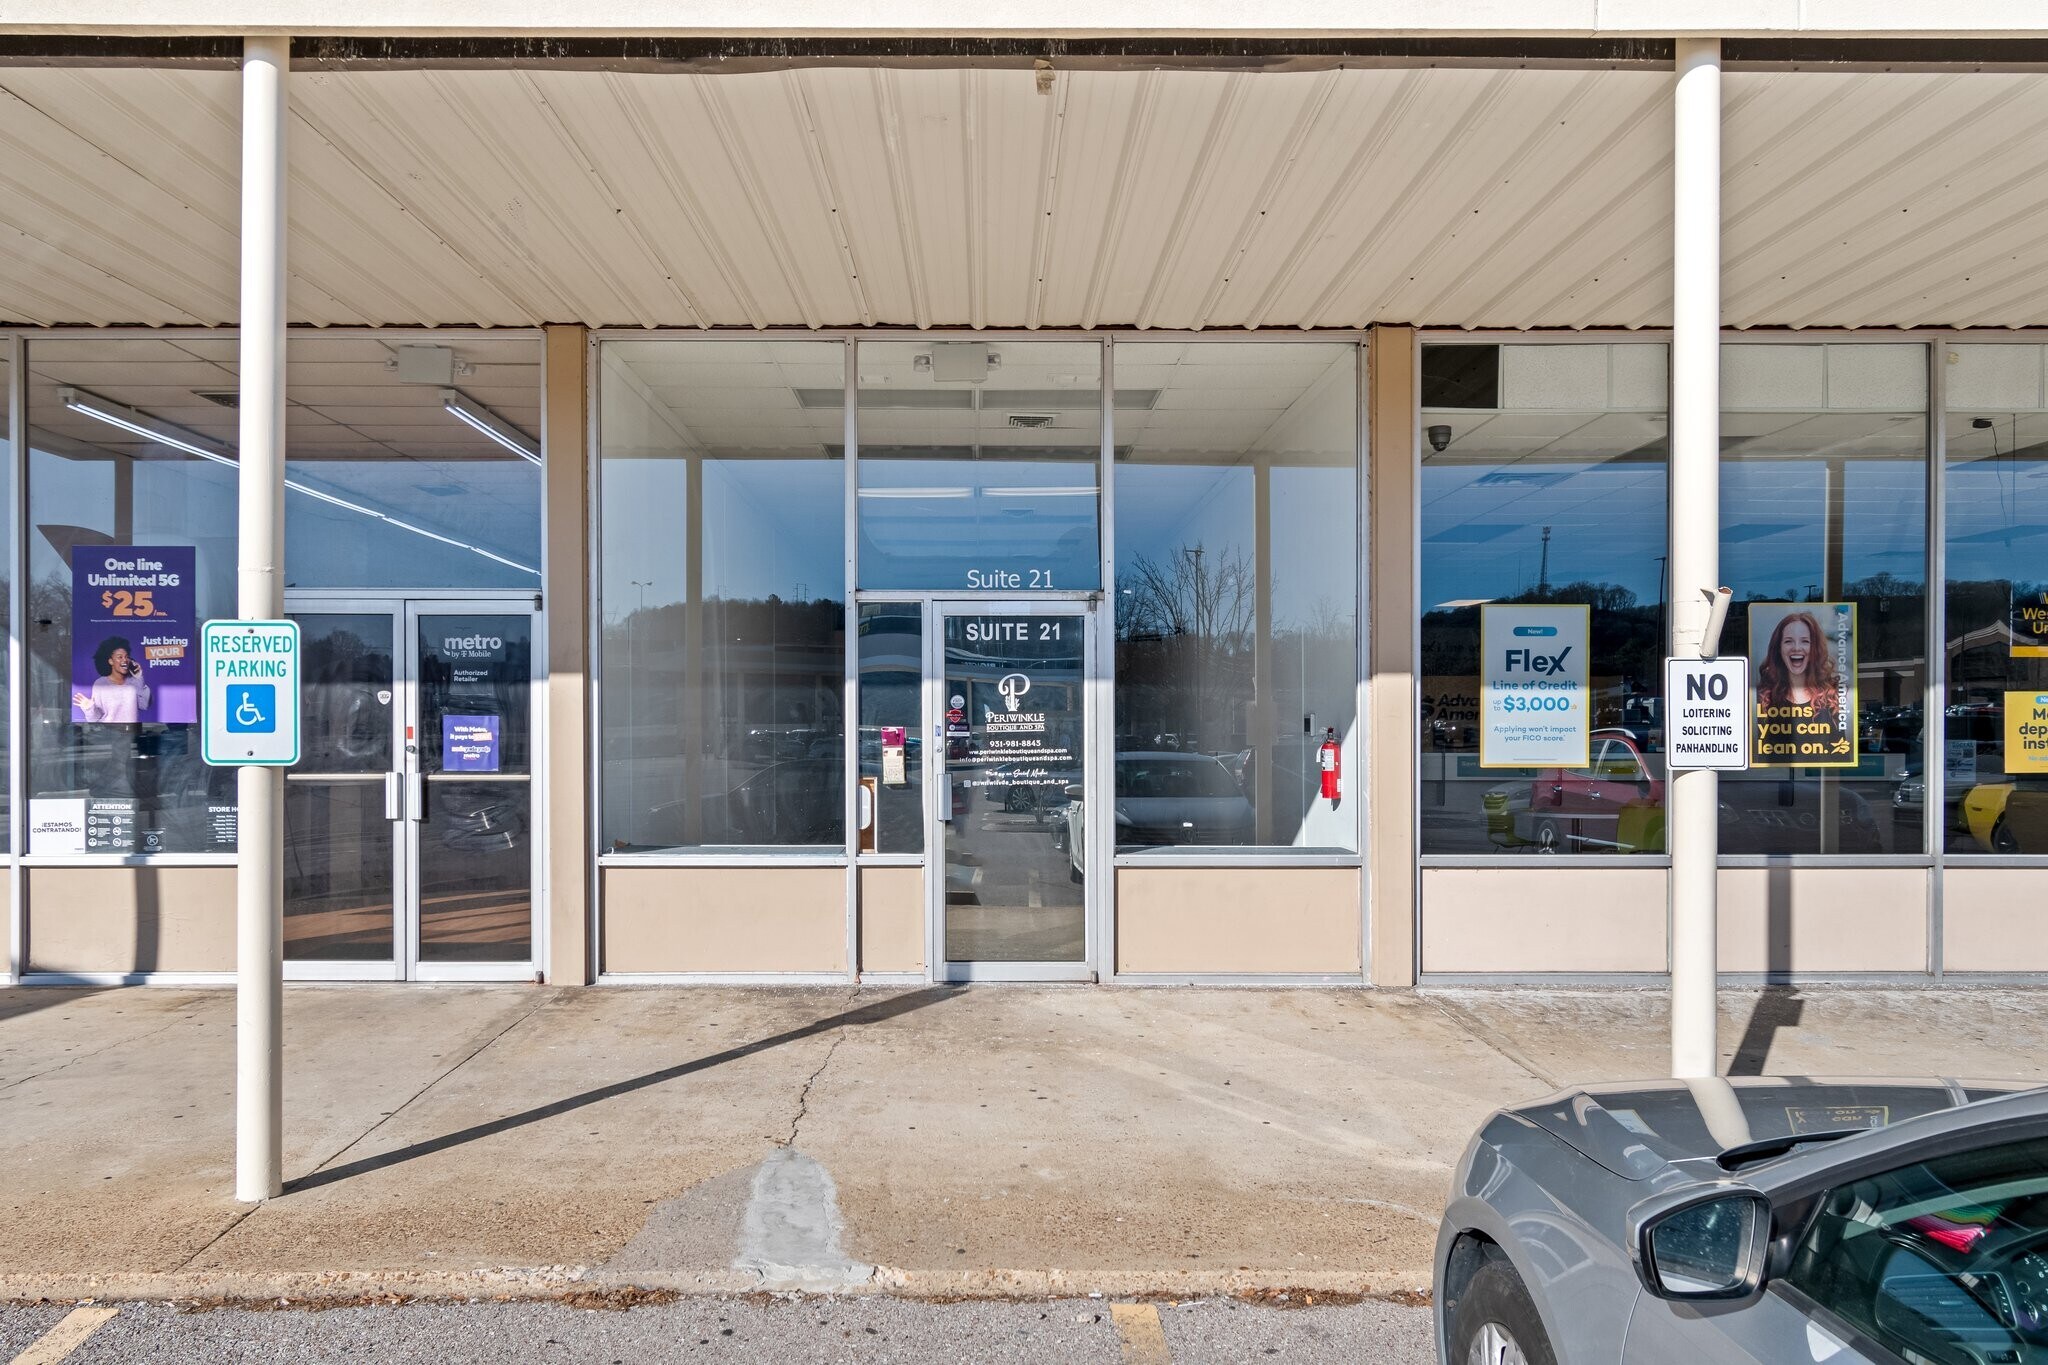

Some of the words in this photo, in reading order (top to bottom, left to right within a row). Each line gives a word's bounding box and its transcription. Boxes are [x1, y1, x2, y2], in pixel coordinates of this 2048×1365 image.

[104, 558, 135, 571] One
[136, 558, 163, 571] line
[87, 574, 157, 587] Unlimited
[158, 574, 180, 587] 5G
[967, 569, 1021, 589] Suite
[1029, 569, 1054, 588] 21
[2022, 607, 2048, 620] We
[966, 622, 1029, 641] SUITE
[1039, 622, 1060, 641] 21
[140, 636, 162, 646] Just
[163, 636, 189, 648] bring
[210, 635, 293, 653] RESERVED
[444, 634, 502, 650] metro
[1838, 612, 1849, 672] Advance
[149, 647, 180, 657] YOUR
[451, 651, 460, 660] by
[468, 650, 492, 658] Mobile
[149, 658, 180, 668] phone
[1505, 646, 1573, 676] Flex
[215, 660, 287, 677] PARKING
[1492, 680, 1519, 691] Line
[1521, 680, 1536, 691] of
[1537, 680, 1578, 691] Credit
[1686, 673, 1729, 701] NO
[1492, 699, 1502, 708] up
[1503, 694, 1570, 713] $3,000
[1838, 673, 1851, 732] America
[985, 711, 1046, 723] PERIWINKLE
[1682, 708, 1731, 718] LOITERING
[1756, 703, 1814, 718] Loans
[1493, 725, 1527, 735] Applying
[1528, 725, 1549, 733] won't
[1550, 726, 1577, 735] impact
[1682, 726, 1732, 736] SOLICITING
[1757, 723, 1792, 739] you
[1796, 722, 1831, 735] can
[1504, 735, 1521, 743] your
[1522, 734, 1542, 742] FICO
[1675, 743, 1739, 753] PANHANDLING
[1757, 739, 1797, 755] lean
[1800, 742, 1829, 755] on.
